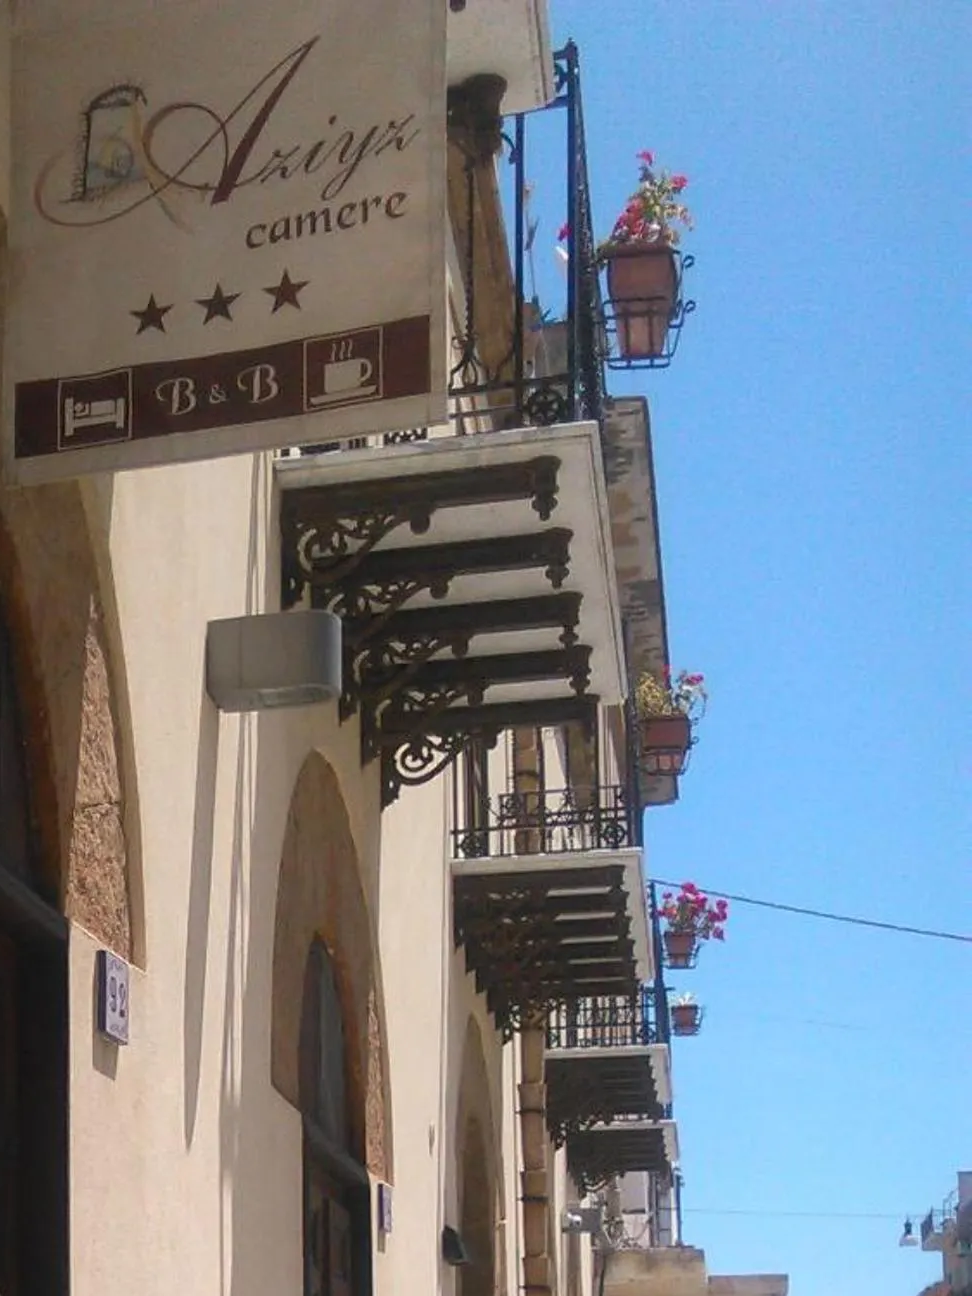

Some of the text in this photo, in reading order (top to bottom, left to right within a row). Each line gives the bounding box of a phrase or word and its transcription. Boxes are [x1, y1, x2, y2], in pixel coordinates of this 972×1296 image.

[245, 191, 408, 249] camere
[156, 364, 279, 415] B & B
[109, 976, 126, 1018] 92
